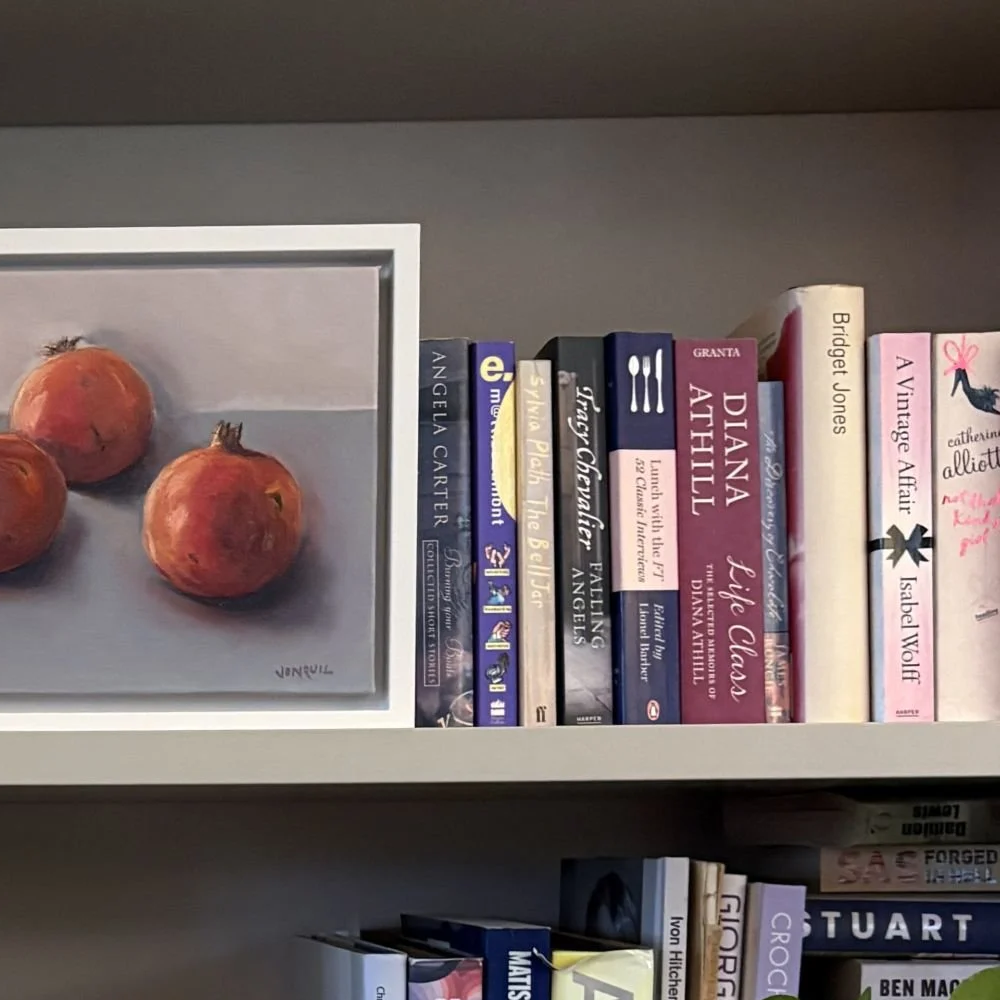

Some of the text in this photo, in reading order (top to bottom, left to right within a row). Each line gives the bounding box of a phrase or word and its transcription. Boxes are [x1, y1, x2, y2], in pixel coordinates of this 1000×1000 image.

[692, 347, 740, 358] GRANTA
[826, 312, 850, 435] Bridget Jones
[432, 351, 449, 528] ANGELA CARTER
[526, 374, 551, 487] Sylvia Plath
[567, 386, 604, 551] Tracy Chevalier
[689, 384, 715, 515] ATHILL
[723, 392, 750, 507] DIANA
[892, 356, 914, 515] A Vintage Affair
[526, 490, 550, 610] The Bell Jar
[635, 457, 648, 583] 52 Classic Interviews
[650, 459, 664, 582] Lunch with the FT
[572, 568, 586, 646] ANGELS
[590, 562, 606, 649] FALLING
[639, 602, 649, 683] Lionel Barber
[652, 602, 663, 660] Edited by
[691, 579, 705, 685] DIANA ATHILL
[706, 563, 716, 700] THE SELECTED MEMOIRS OF
[719, 554, 758, 704] Life Class
[900, 577, 920, 684] Isabel Wolff
[925, 850, 998, 865] FORGED
[671, 916, 683, 945] Ivon
[880, 979, 915, 997] BEN
